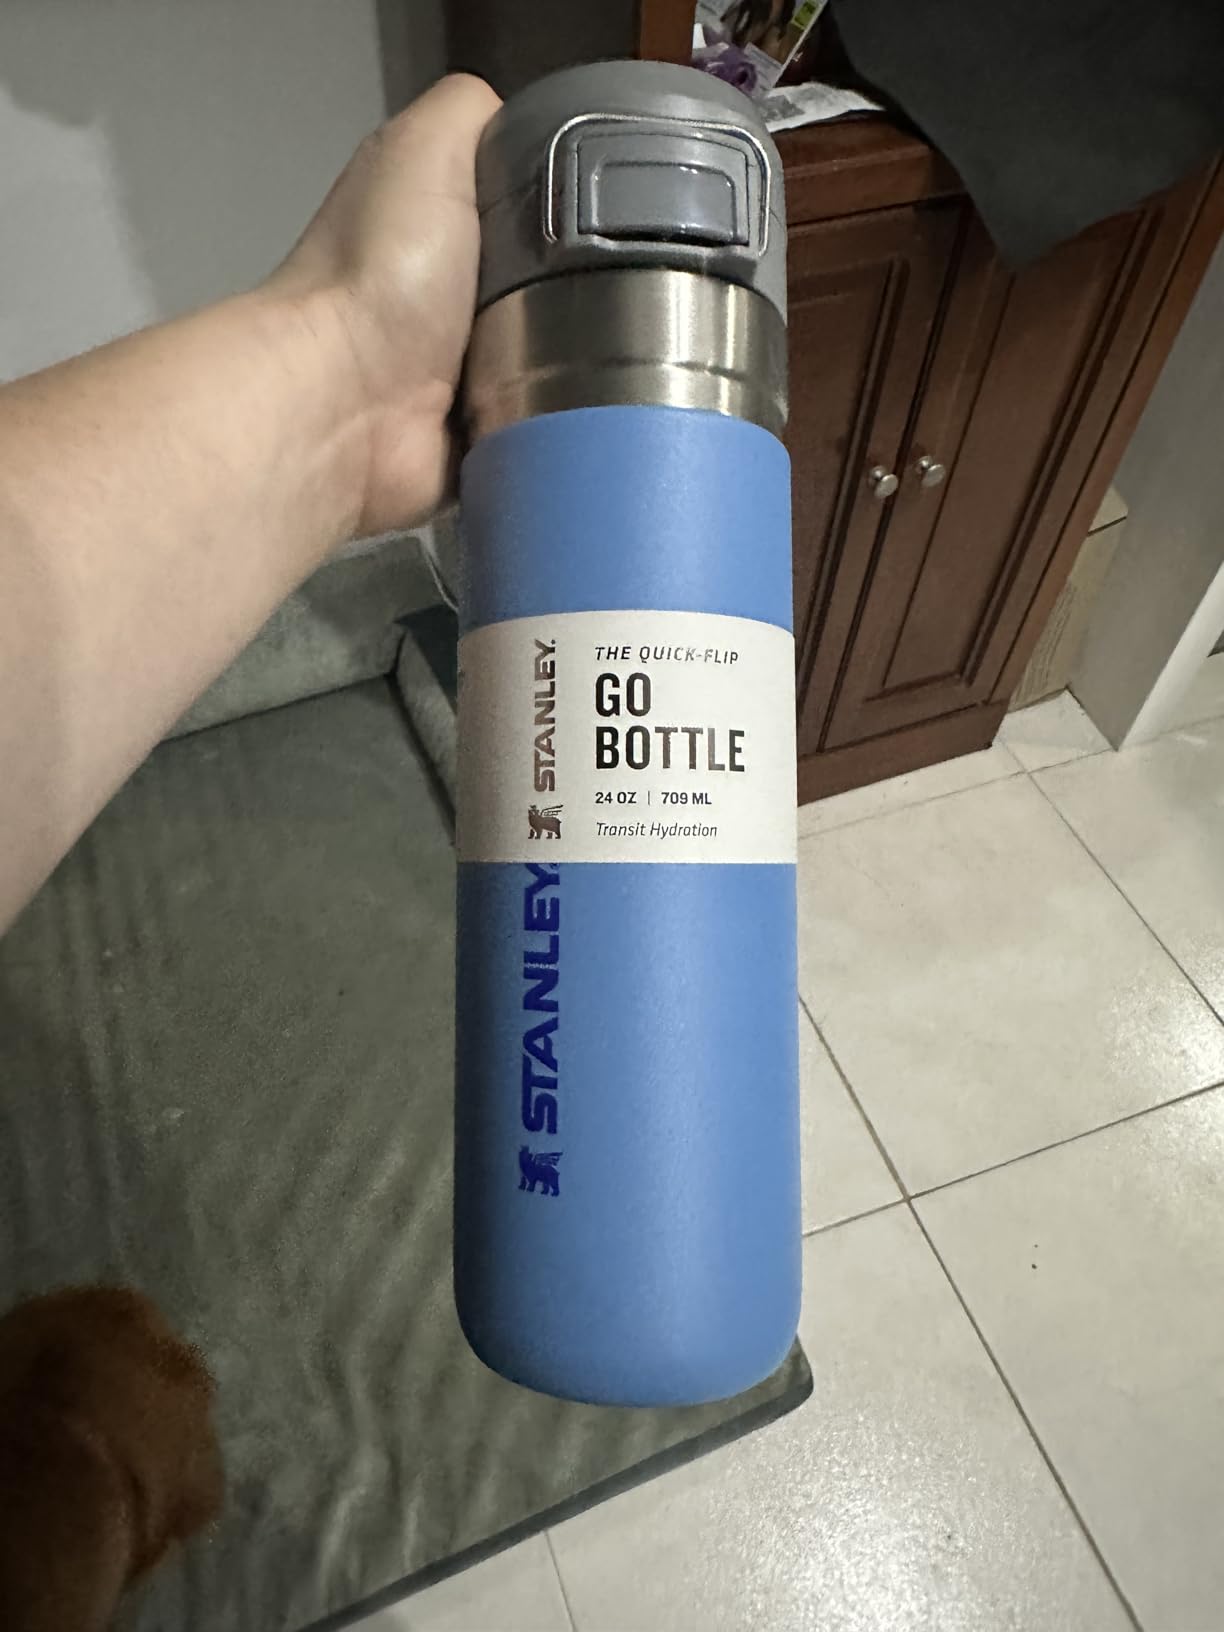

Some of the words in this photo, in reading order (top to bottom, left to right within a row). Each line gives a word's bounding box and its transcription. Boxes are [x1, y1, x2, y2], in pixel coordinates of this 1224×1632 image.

[595, 646, 632, 661] THE
[639, 646, 739, 665] QUICK-FLIP
[595, 672, 651, 717] GO
[595, 726, 745, 773] BOTTLE
[595, 791, 613, 804] 24
[617, 791, 637, 804] OZ
[661, 792, 688, 805] 709
[692, 792, 712, 805] ML
[596, 822, 646, 837] Transit
[650, 822, 718, 840] Hydration
